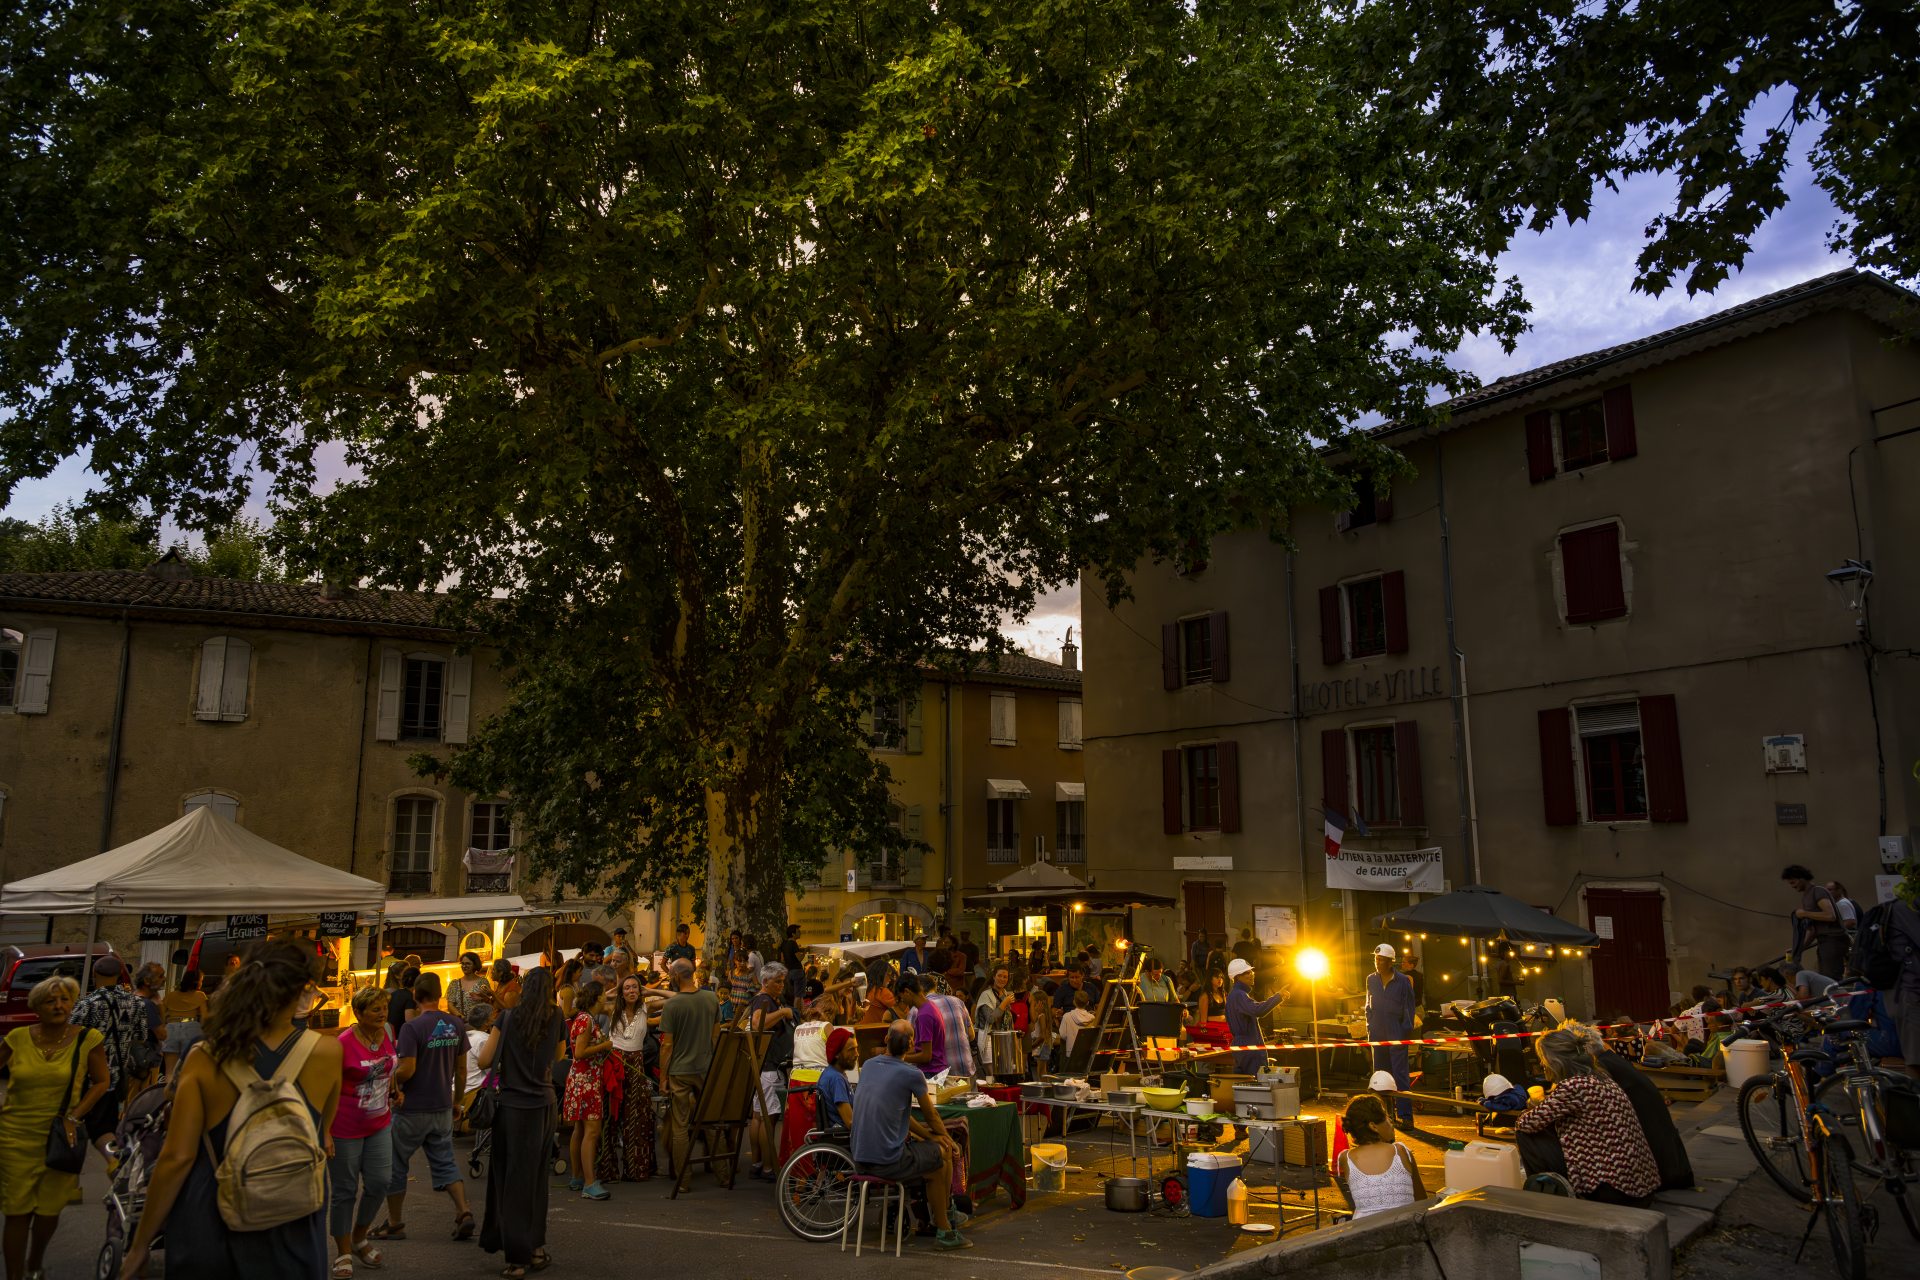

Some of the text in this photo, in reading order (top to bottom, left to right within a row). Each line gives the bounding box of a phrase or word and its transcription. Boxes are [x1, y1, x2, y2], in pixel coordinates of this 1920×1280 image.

[1384, 666, 1442, 703] VILLE
[1374, 854, 1383, 862] la
[1356, 866, 1408, 877] de GANGES
[144, 914, 178, 925] POULET
[427, 1035, 460, 1049] element
